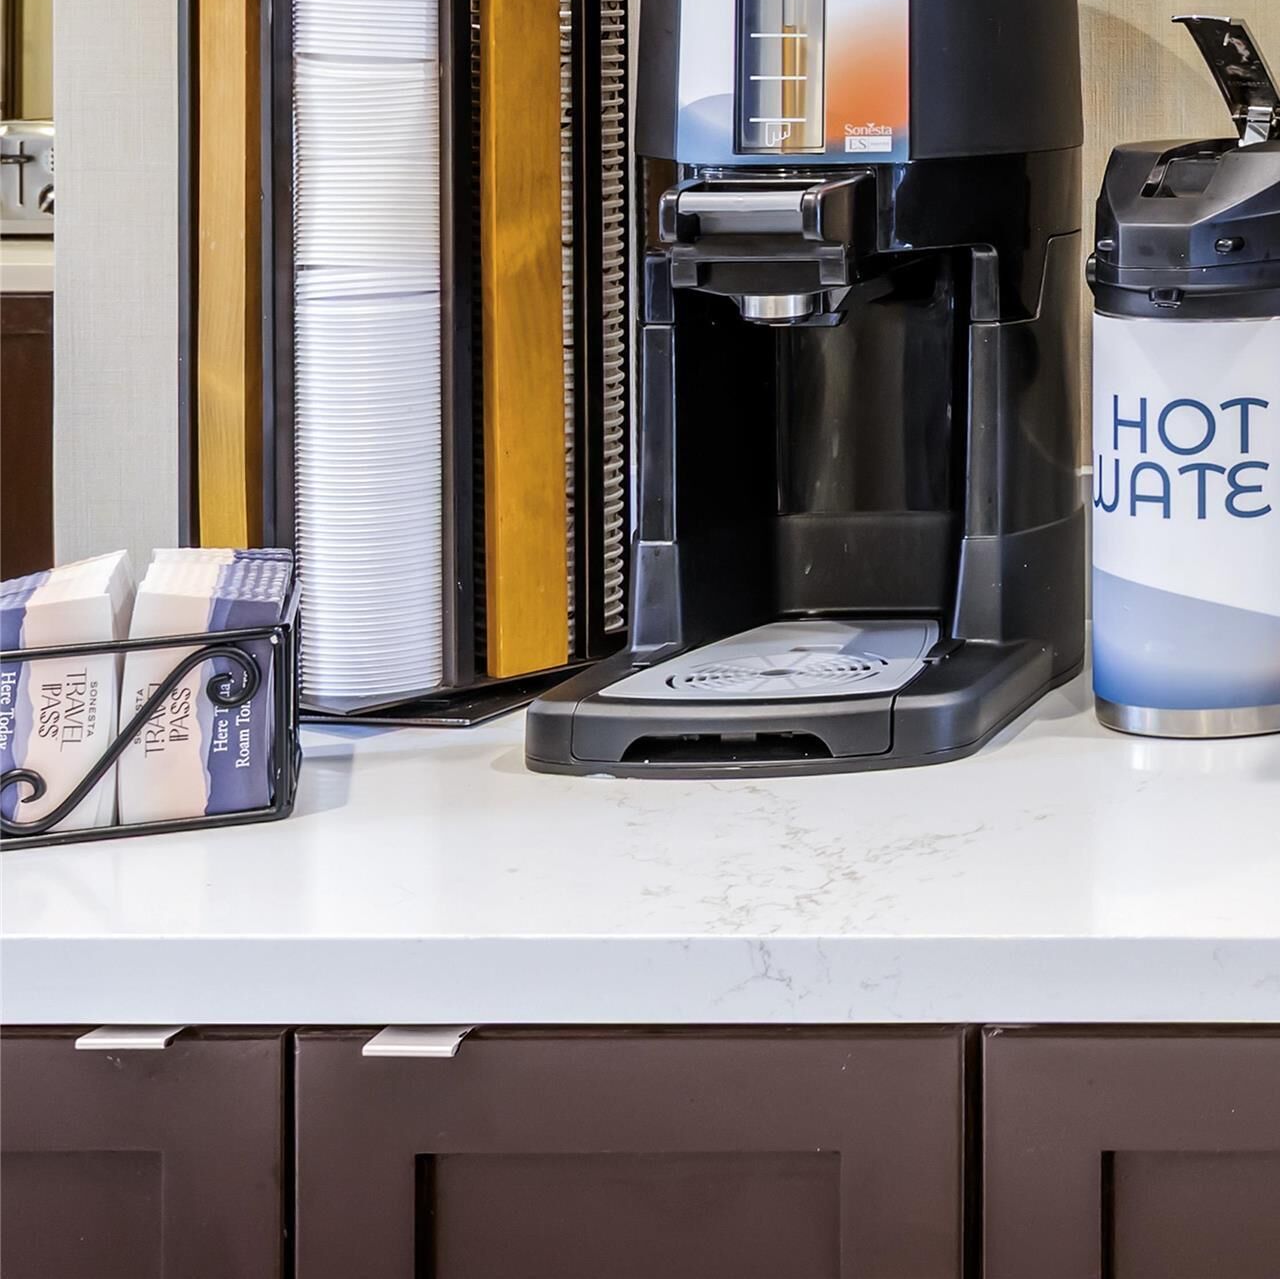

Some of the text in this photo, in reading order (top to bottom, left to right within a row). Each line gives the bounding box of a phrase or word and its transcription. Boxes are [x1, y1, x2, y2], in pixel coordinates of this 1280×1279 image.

[844, 122, 893, 136] Sonesta
[1113, 394, 1269, 456] HOT
[1, 671, 16, 705] Here
[38, 683, 62, 738] PASS
[60, 667, 87, 752] TRAVEL
[86, 681, 98, 737] SONESTA
[213, 719, 229, 753] Here
[235, 729, 250, 769] Roam
